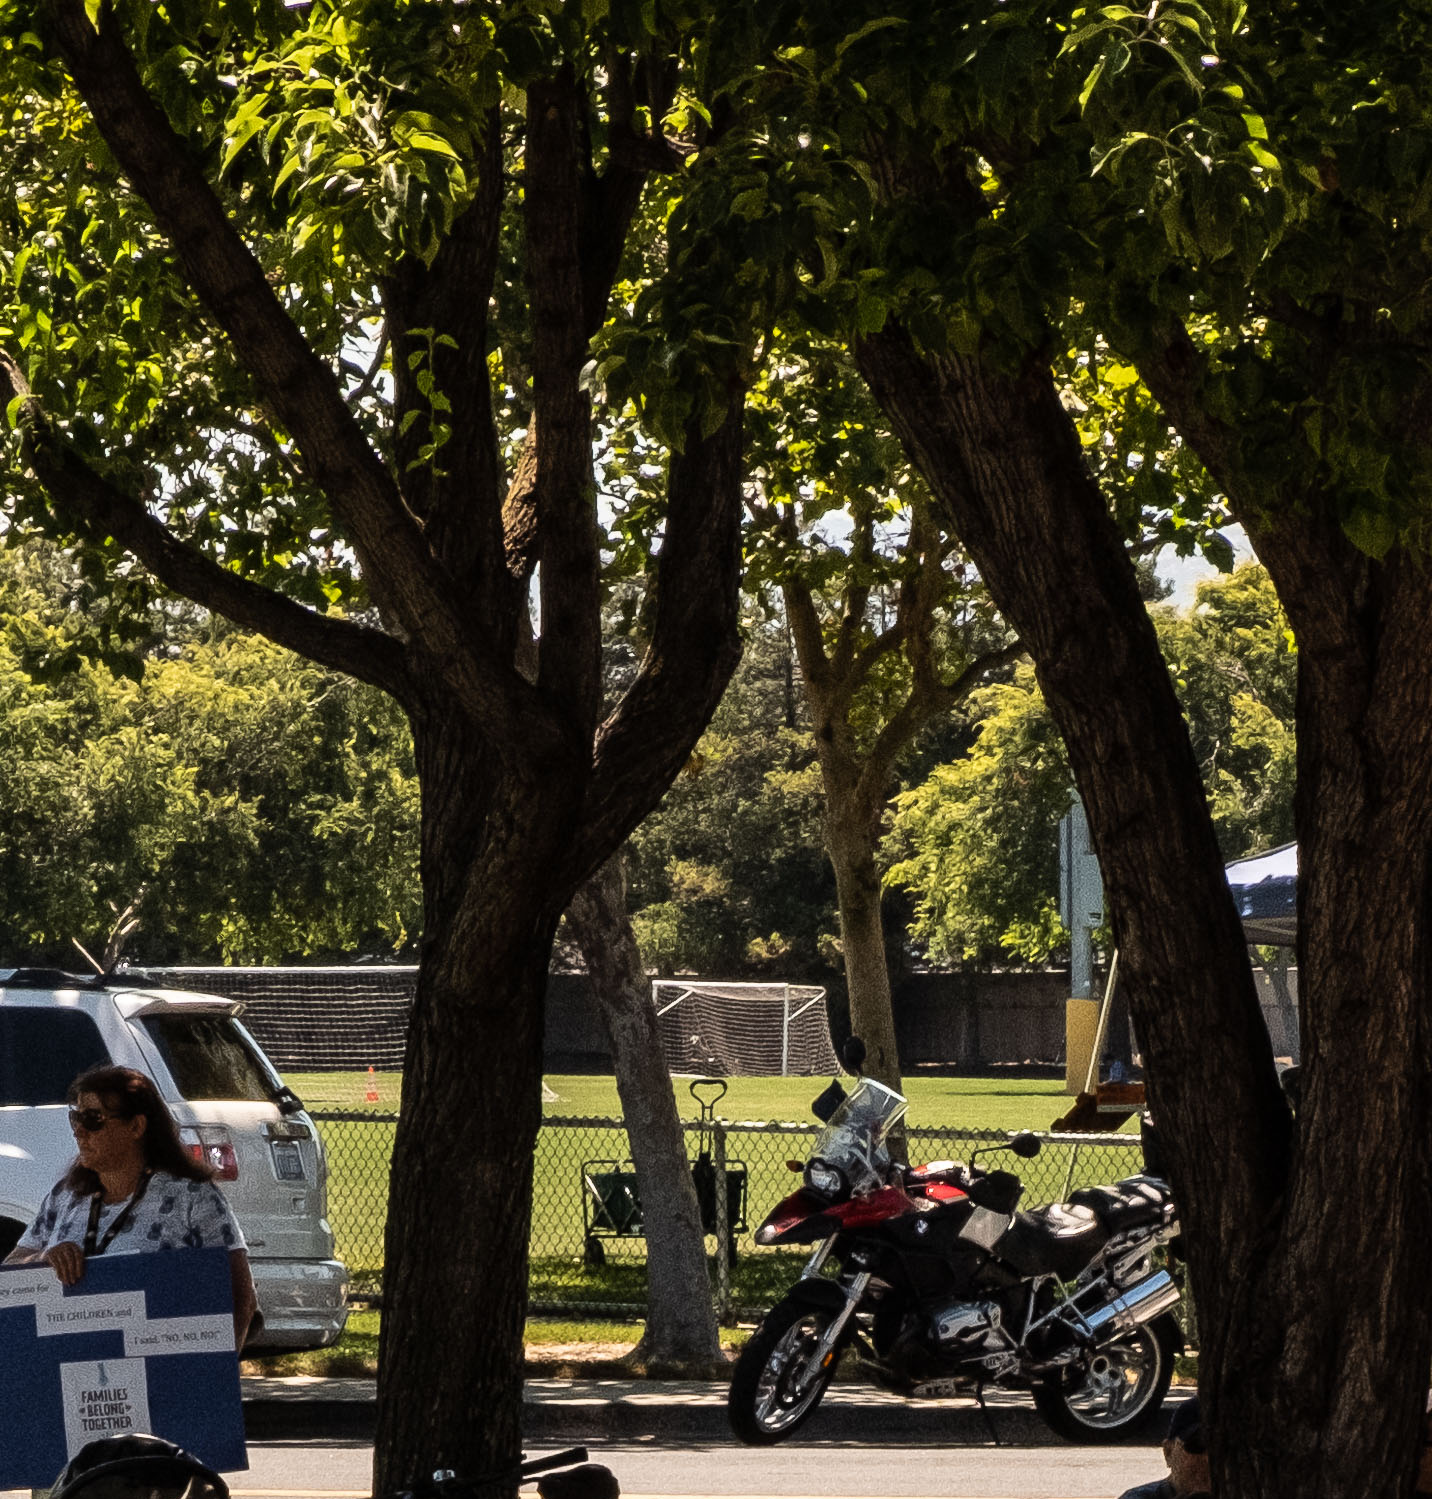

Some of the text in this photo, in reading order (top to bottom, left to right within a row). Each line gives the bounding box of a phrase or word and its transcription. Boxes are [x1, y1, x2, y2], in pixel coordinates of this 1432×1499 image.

[46, 1312, 65, 1322] THE
[67, 1308, 114, 1321] CHILDREN
[81, 1388, 128, 1403] FAMILIES
[87, 1403, 125, 1417] BELONG
[82, 1416, 133, 1431] TOGETHER
